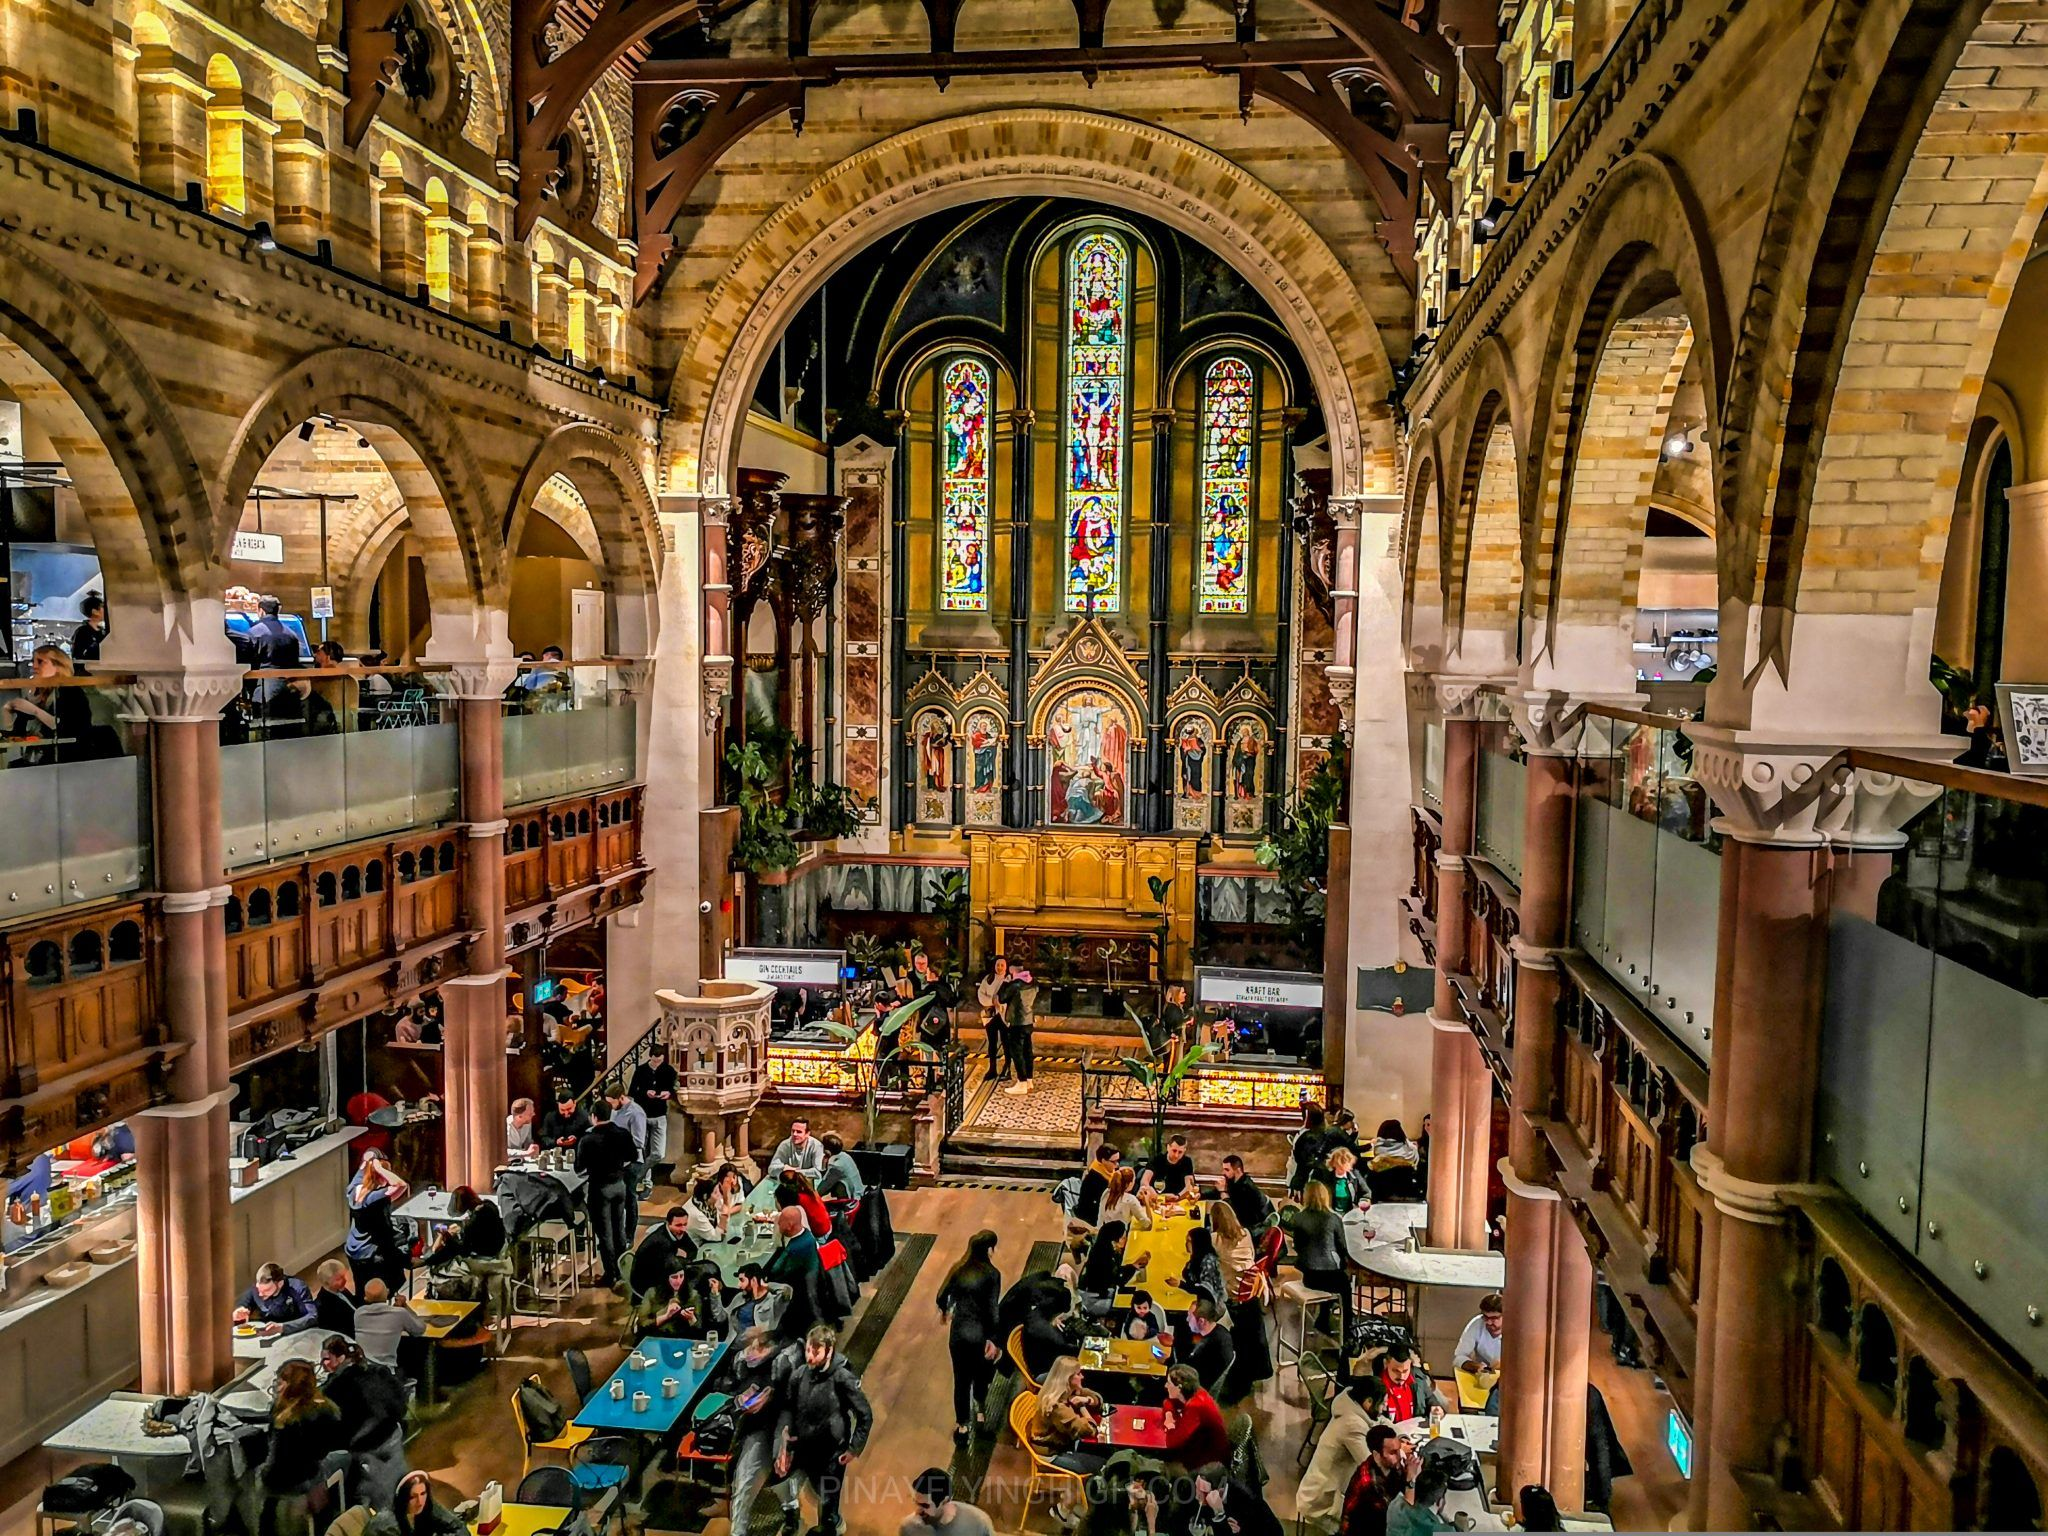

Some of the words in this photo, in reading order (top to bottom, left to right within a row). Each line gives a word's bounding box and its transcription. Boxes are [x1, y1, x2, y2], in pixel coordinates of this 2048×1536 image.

[759, 964, 769, 973] GIN
[770, 965, 803, 975] COCKTAILS
[1245, 986, 1266, 995] KRAFT
[1267, 987, 1281, 996] BAR
